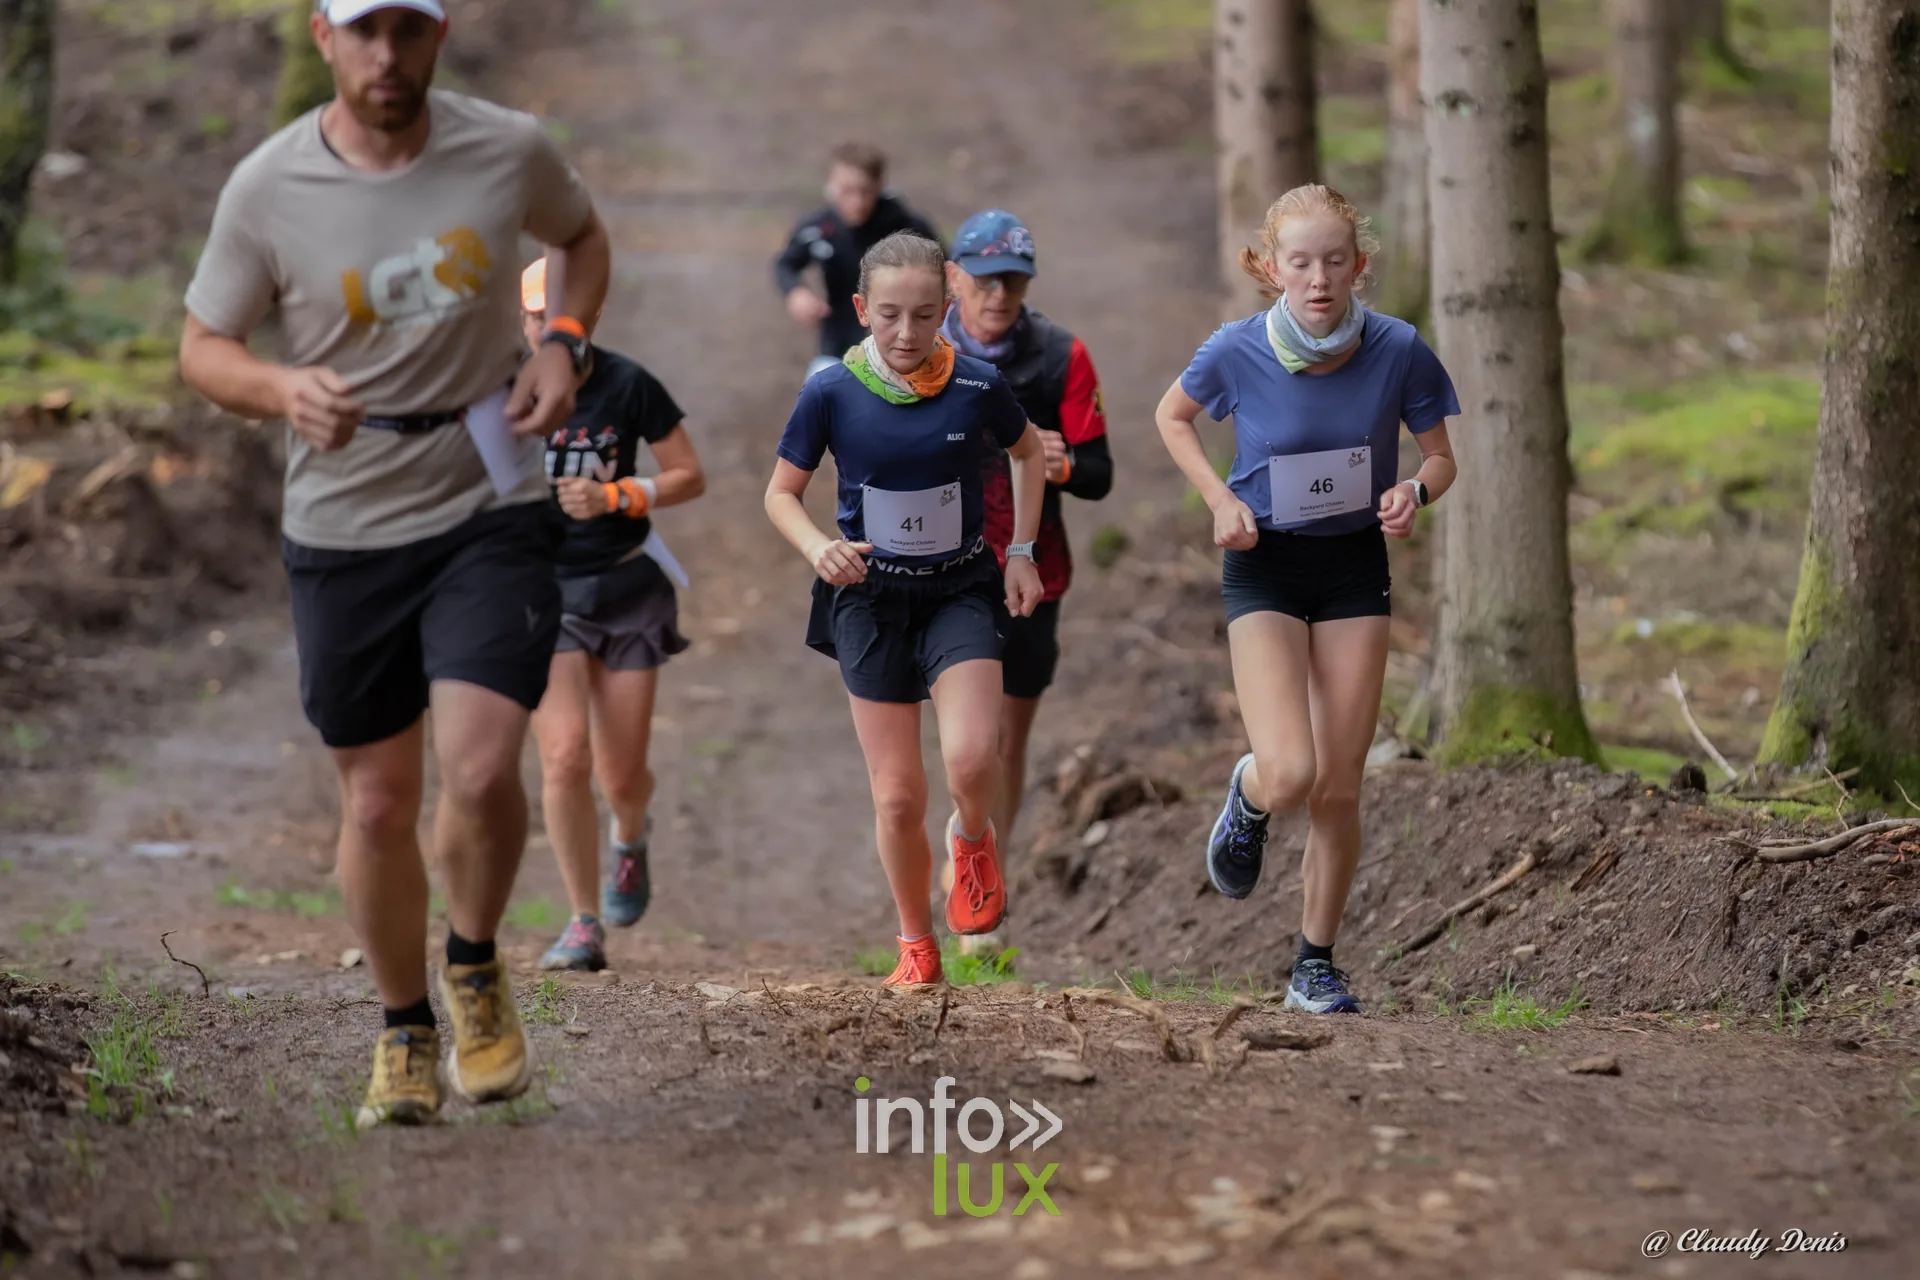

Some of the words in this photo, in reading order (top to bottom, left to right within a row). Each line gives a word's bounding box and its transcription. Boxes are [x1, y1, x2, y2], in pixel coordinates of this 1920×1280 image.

[955, 377, 984, 388] CRAFT
[946, 432, 966, 441] ALICE
[1309, 477, 1334, 495] 46
[1299, 503, 1325, 512] Backyard
[900, 516, 924, 532] 41
[889, 538, 915, 547] Backyard
